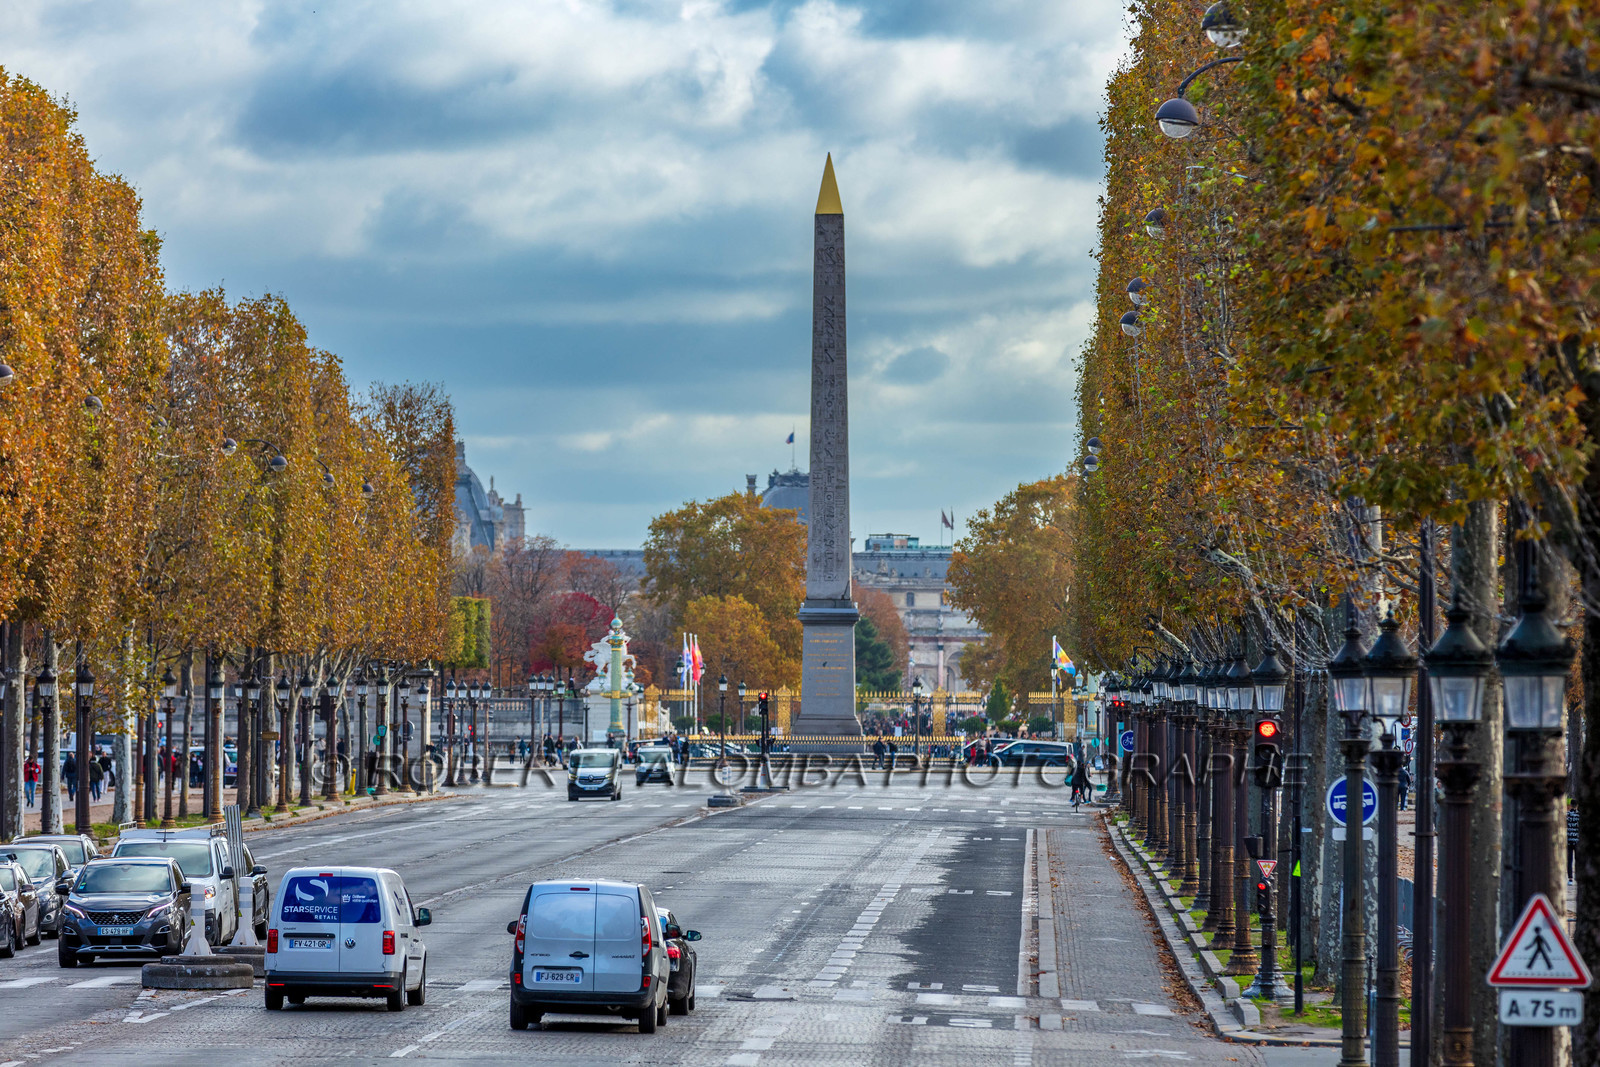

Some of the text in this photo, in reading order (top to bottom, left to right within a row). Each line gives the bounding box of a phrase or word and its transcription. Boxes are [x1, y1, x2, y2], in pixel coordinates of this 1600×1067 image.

[284, 905, 338, 914] STARSERVICE
[1508, 999, 1577, 1019] A 75 m
